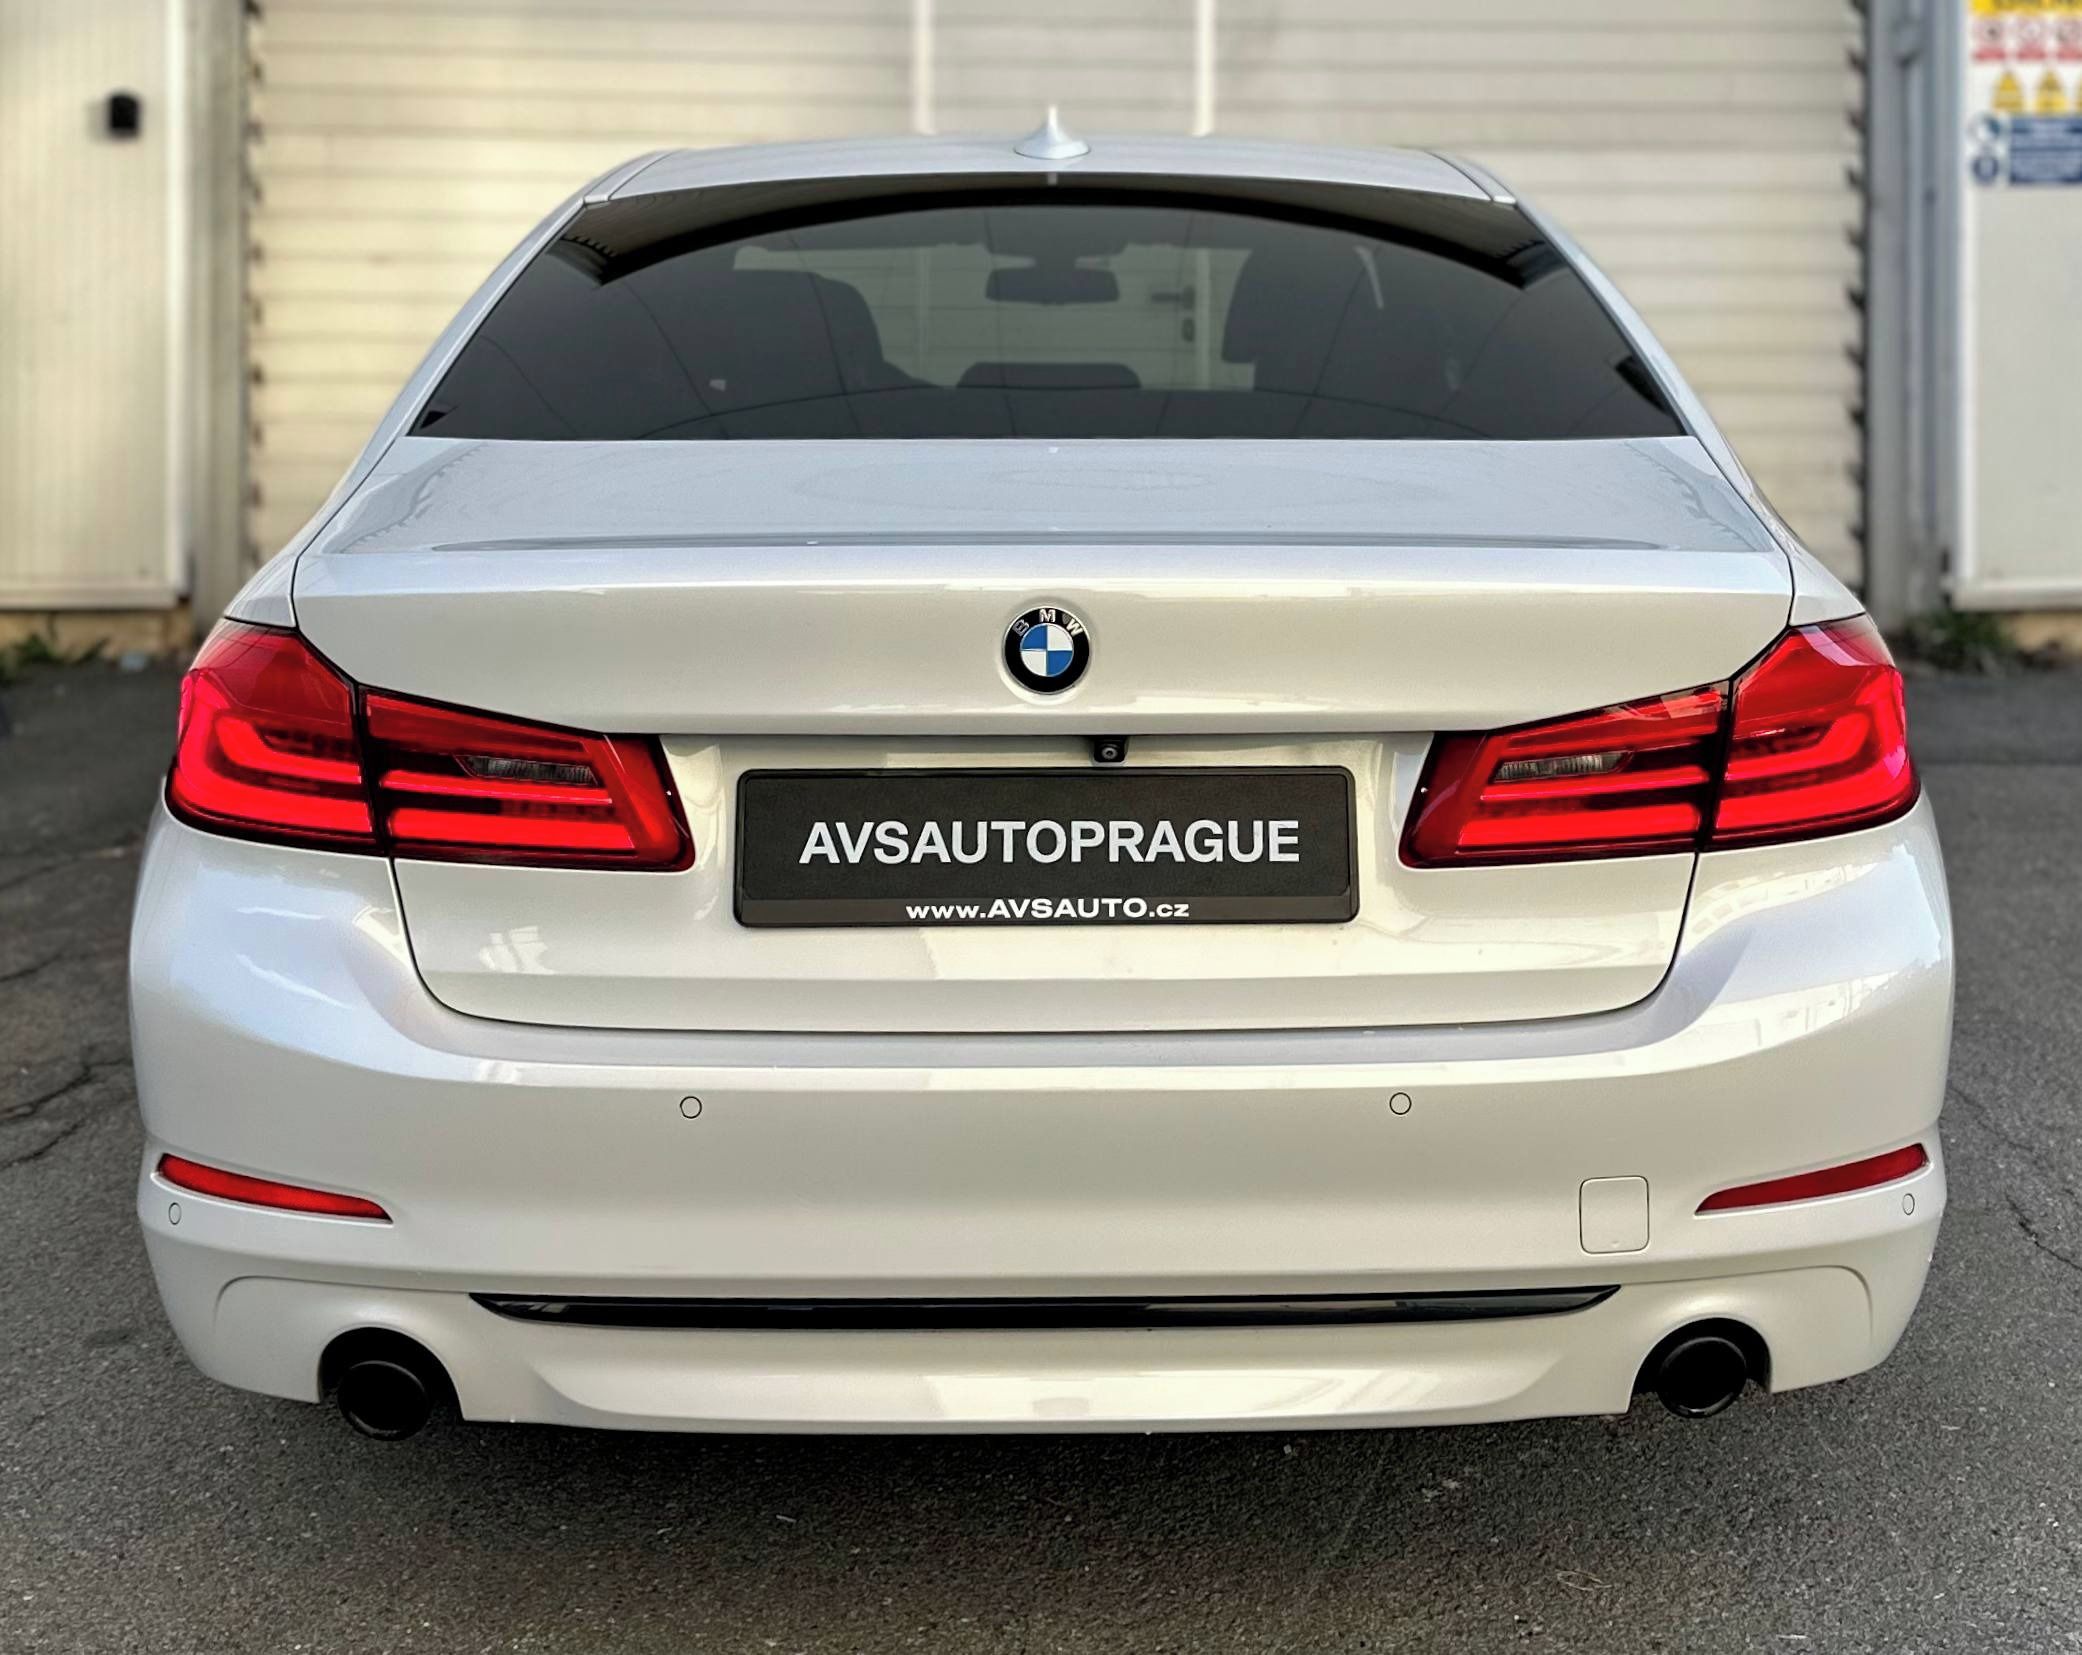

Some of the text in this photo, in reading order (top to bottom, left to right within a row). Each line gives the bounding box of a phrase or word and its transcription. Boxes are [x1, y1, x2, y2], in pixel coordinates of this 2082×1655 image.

[1012, 608, 1083, 637] BMW
[799, 820, 1299, 864] AVSAUTOPRAGUE
[905, 897, 1190, 919] www.AVSAUTO.cz
